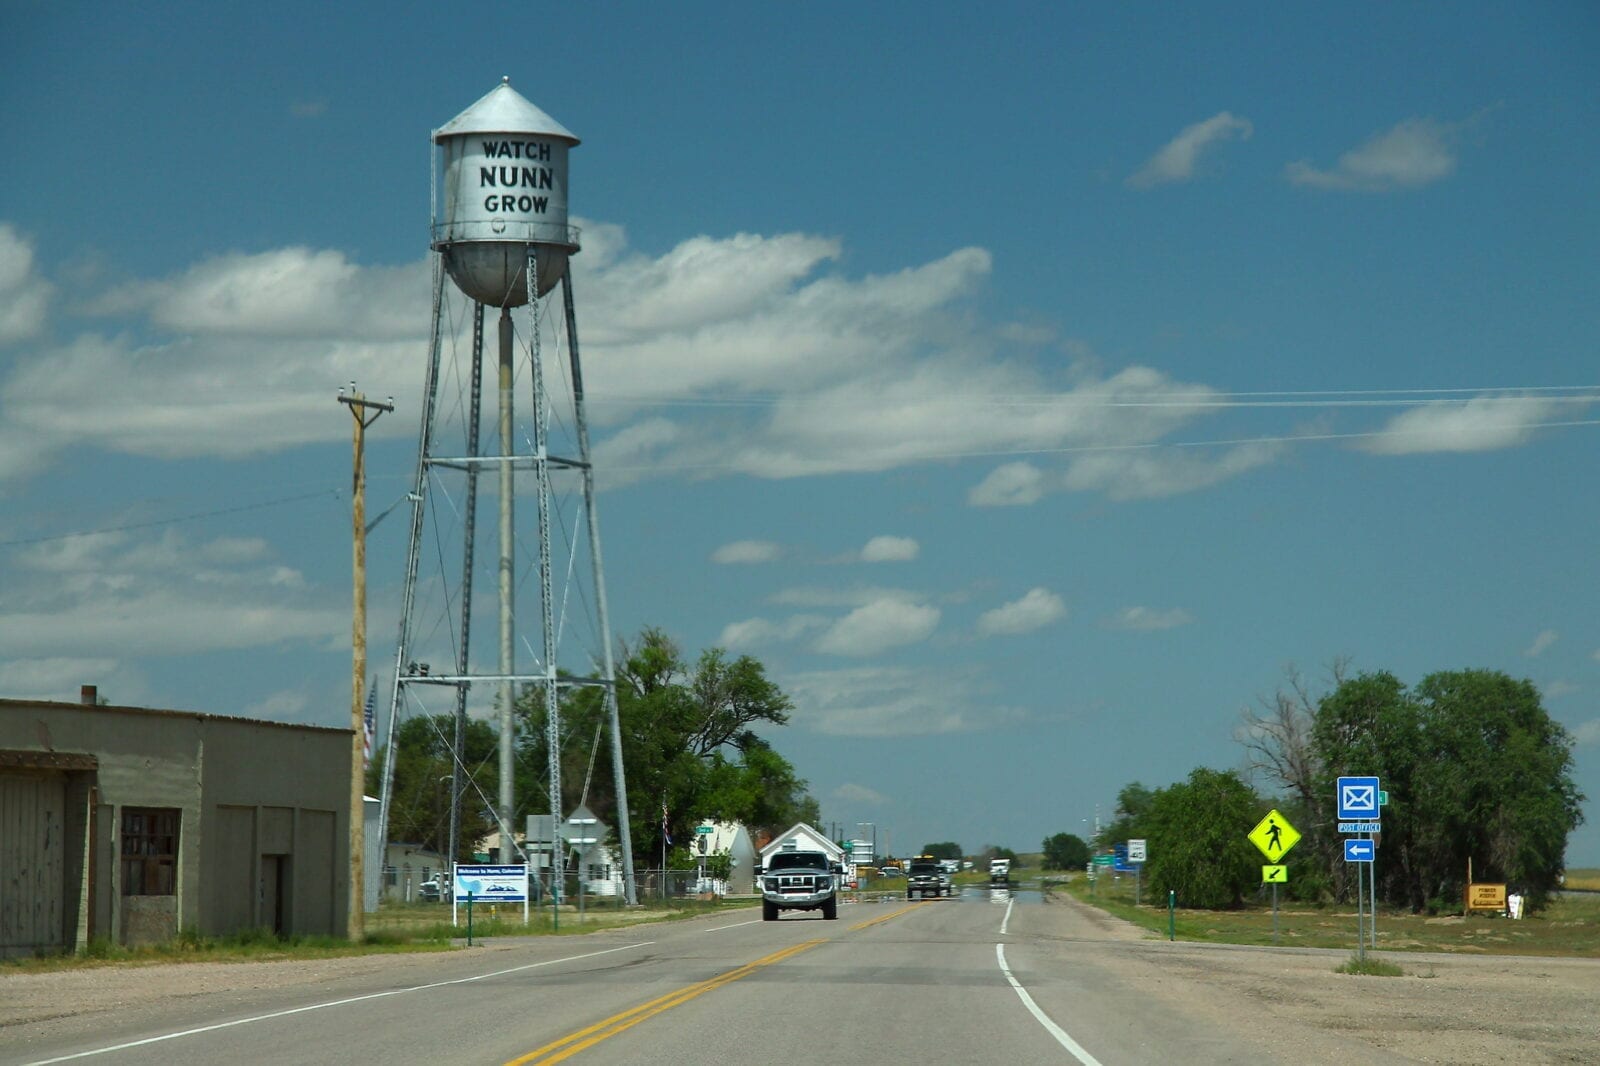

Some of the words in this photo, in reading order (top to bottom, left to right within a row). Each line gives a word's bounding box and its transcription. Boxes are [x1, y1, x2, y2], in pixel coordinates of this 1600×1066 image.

[483, 141, 551, 161] WATCH
[480, 166, 553, 191] NUNN
[484, 195, 548, 214] GROW
